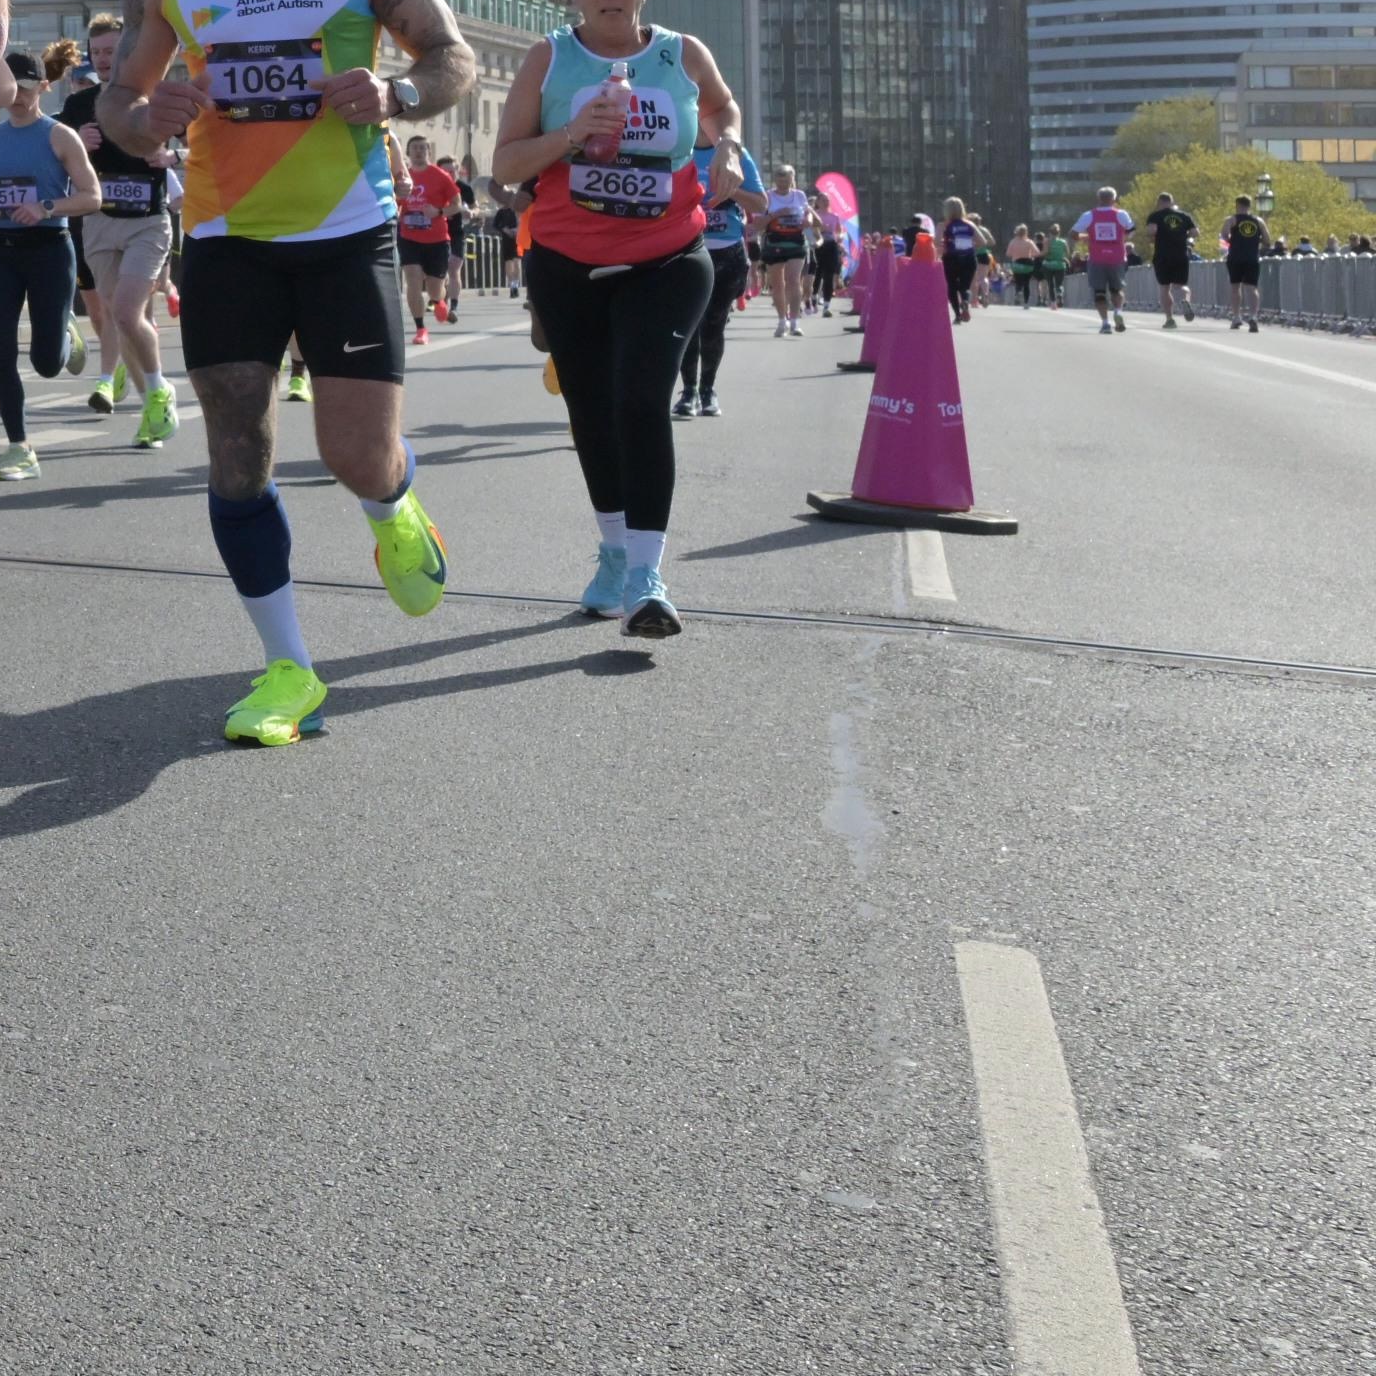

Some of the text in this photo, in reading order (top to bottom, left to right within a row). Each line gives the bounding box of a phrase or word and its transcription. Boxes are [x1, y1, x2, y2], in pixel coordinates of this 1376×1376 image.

[237, 4, 275, 17] about
[247, 44, 277, 55] KERRY
[223, 63, 308, 95] 1064
[624, 114, 671, 131] OUR
[615, 156, 632, 165] LOU
[105, 184, 143, 199] 1686
[583, 170, 657, 199] 2662
